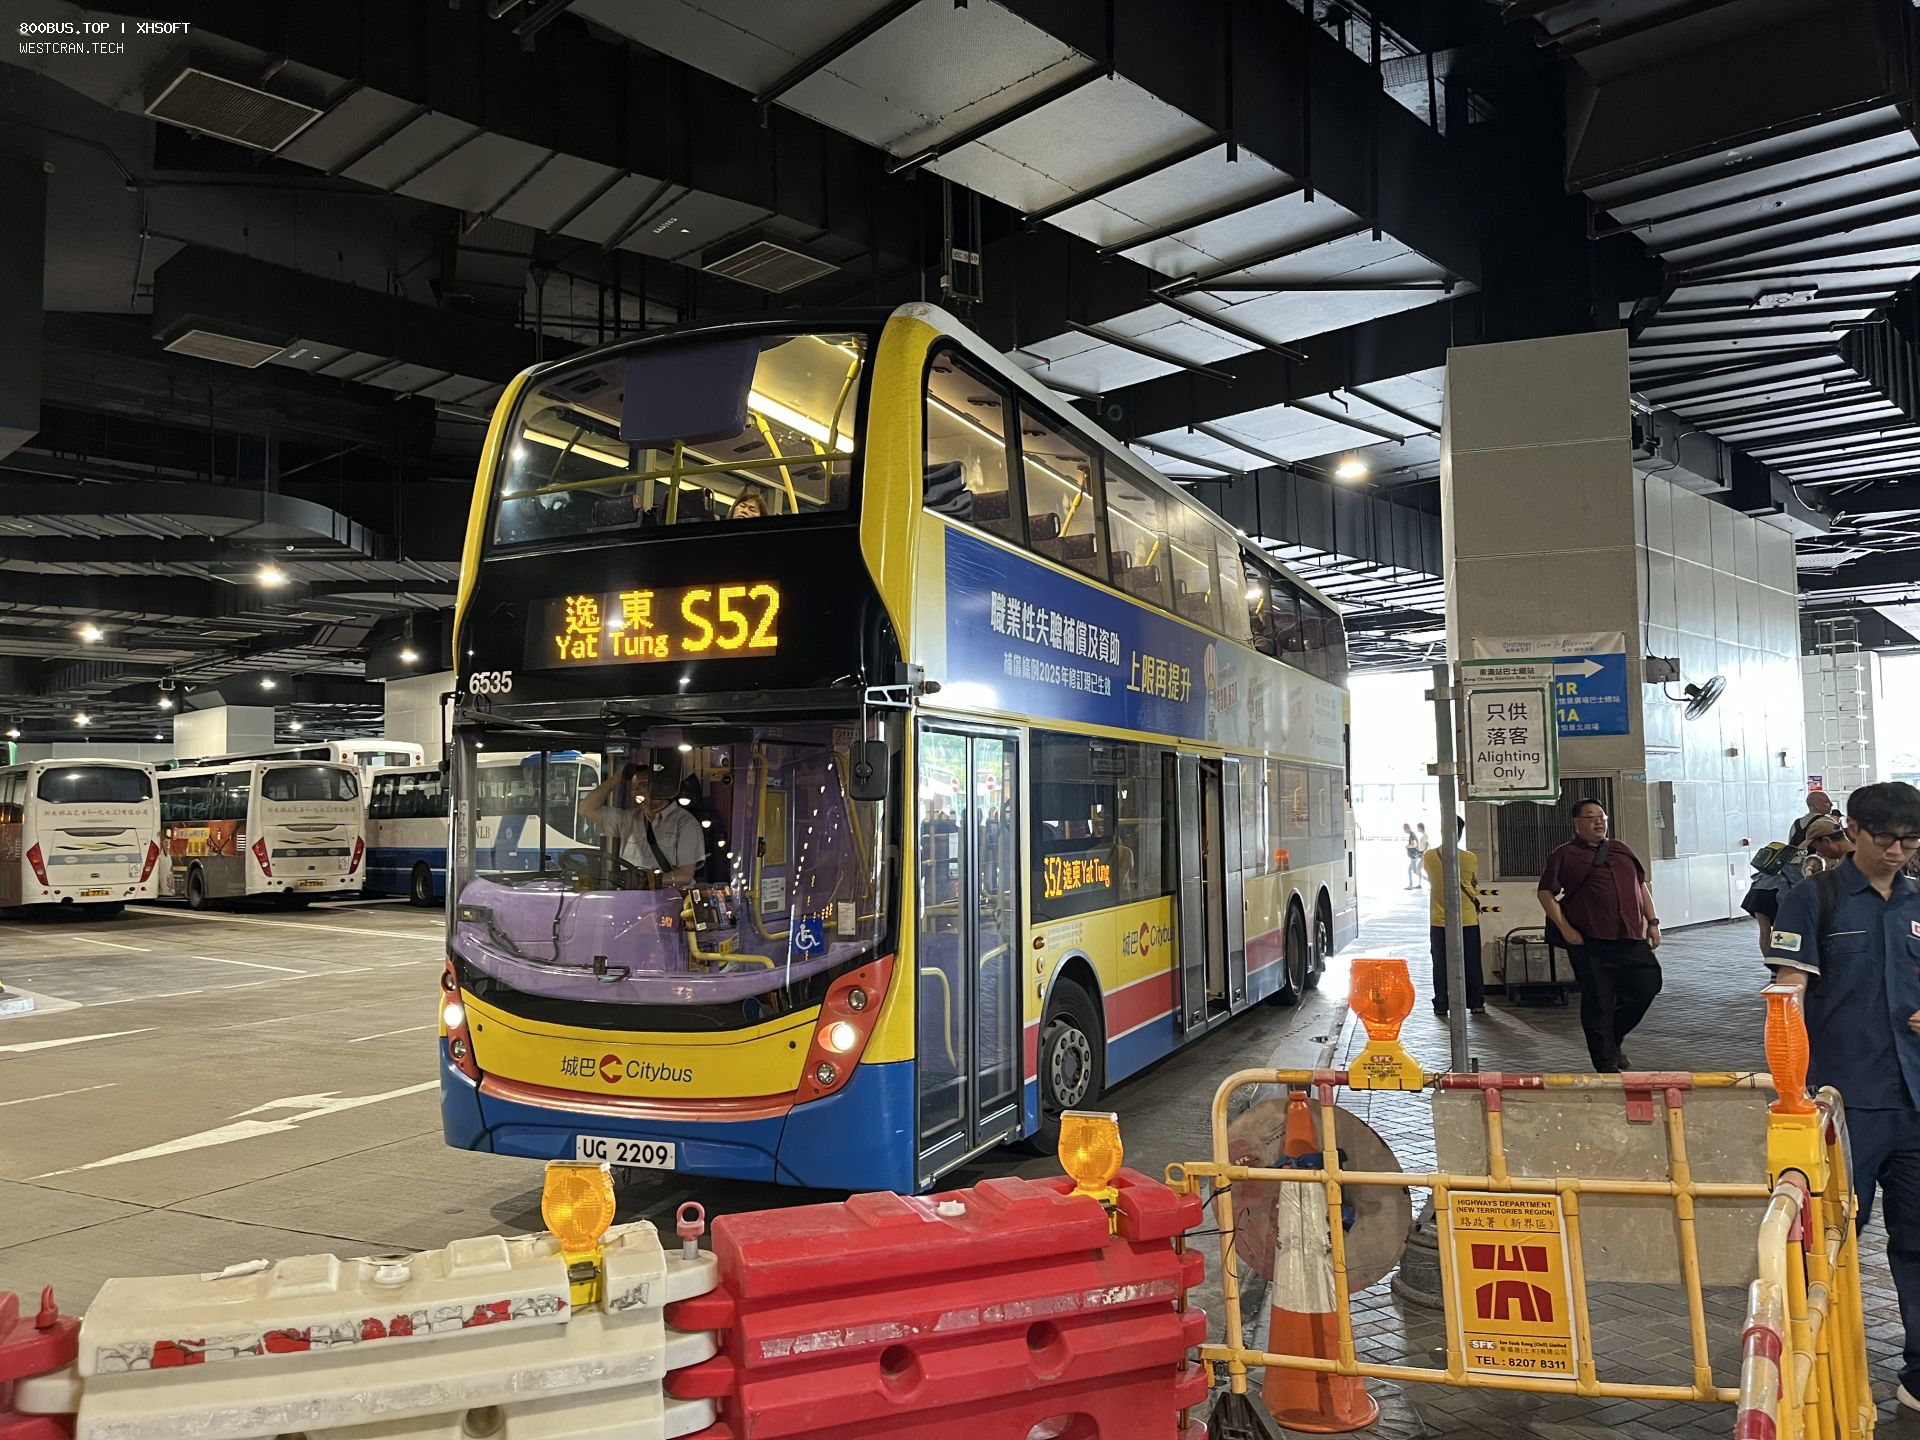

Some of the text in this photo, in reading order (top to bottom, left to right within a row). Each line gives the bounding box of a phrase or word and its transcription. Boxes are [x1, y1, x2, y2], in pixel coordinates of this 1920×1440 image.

[565, 590, 654, 635] 逸東
[680, 584, 780, 652] S52
[990, 590, 1120, 666] 職業性失聰補償及資助
[555, 631, 670, 660] Yat Tung
[469, 670, 513, 695] 6535
[1126, 650, 1192, 703] 上限再提升
[1486, 702, 1528, 722] 只供
[1486, 727, 1528, 746] 落客
[1477, 750, 1540, 765] Alighting
[1493, 766, 1526, 780] Only
[1082, 859, 1094, 884] Yat
[1094, 858, 1112, 888] Tung
[1122, 922, 1176, 957] 城巴 Citybus
[560, 1055, 693, 1083] 城巴 Citybus
[583, 1138, 668, 1165] UG 2209
[1457, 1199, 1552, 1208] HIGHWAYS DEPARTMENT
[1476, 1207, 1523, 1215] TERRITORIES
[1524, 1208, 1555, 1217] REGION)
[1460, 1217, 1496, 1228] 路政署
[1472, 1340, 1495, 1350] SFK
[1508, 1358, 1536, 1368] 8207
[1540, 1360, 1566, 1369] 8311
